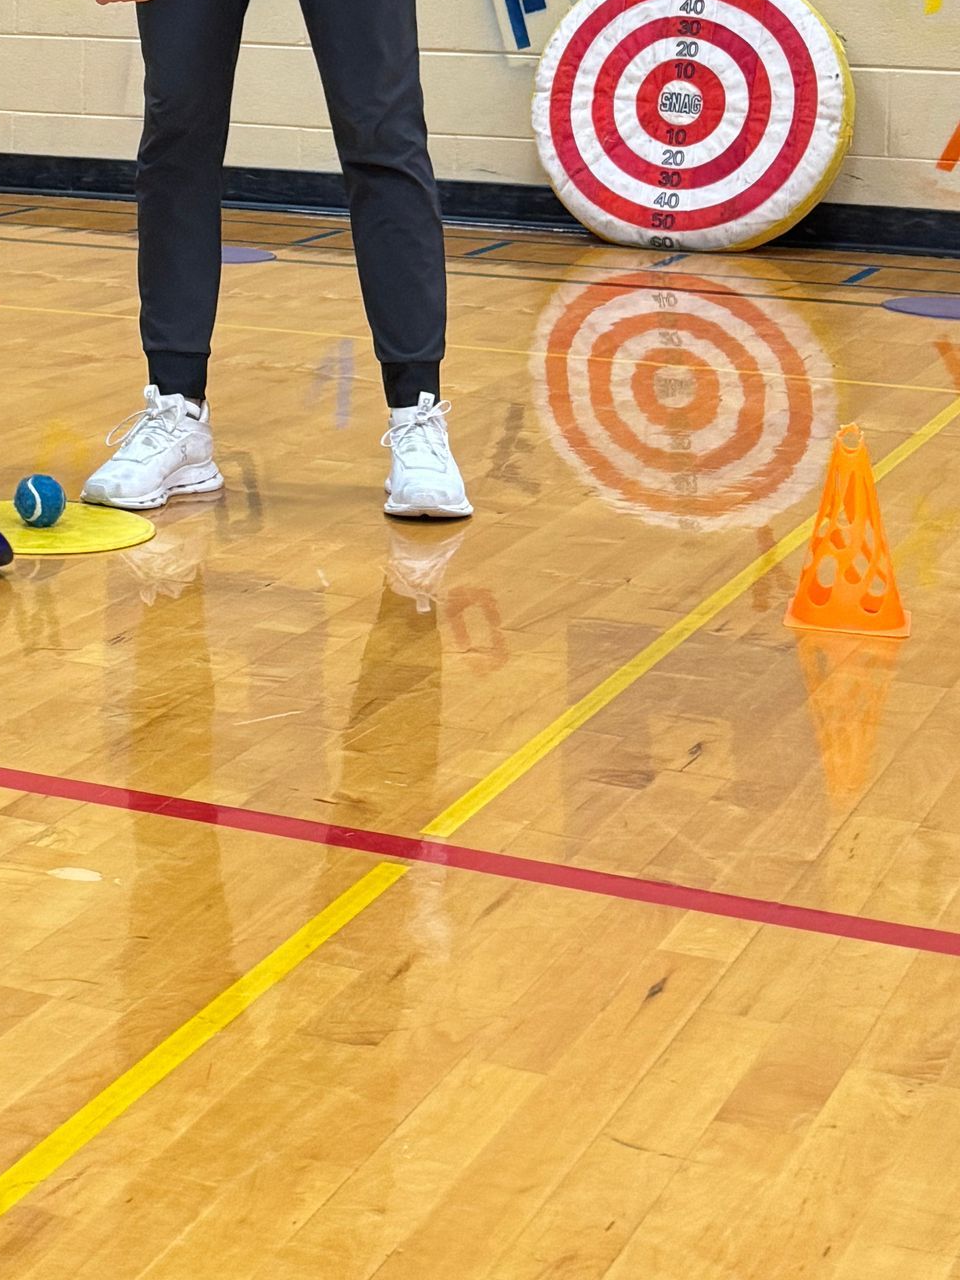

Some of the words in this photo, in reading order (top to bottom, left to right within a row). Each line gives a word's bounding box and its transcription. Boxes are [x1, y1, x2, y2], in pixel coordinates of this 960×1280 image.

[678, 20, 701, 36] 30
[675, 41, 699, 58] 20
[675, 63, 695, 78] 10
[659, 92, 702, 114] SNAG
[665, 129, 686, 145] 10
[662, 150, 685, 166] 20
[658, 171, 681, 187] 30
[653, 192, 679, 208] 40
[652, 213, 675, 229] 50
[650, 236, 674, 248] 60
